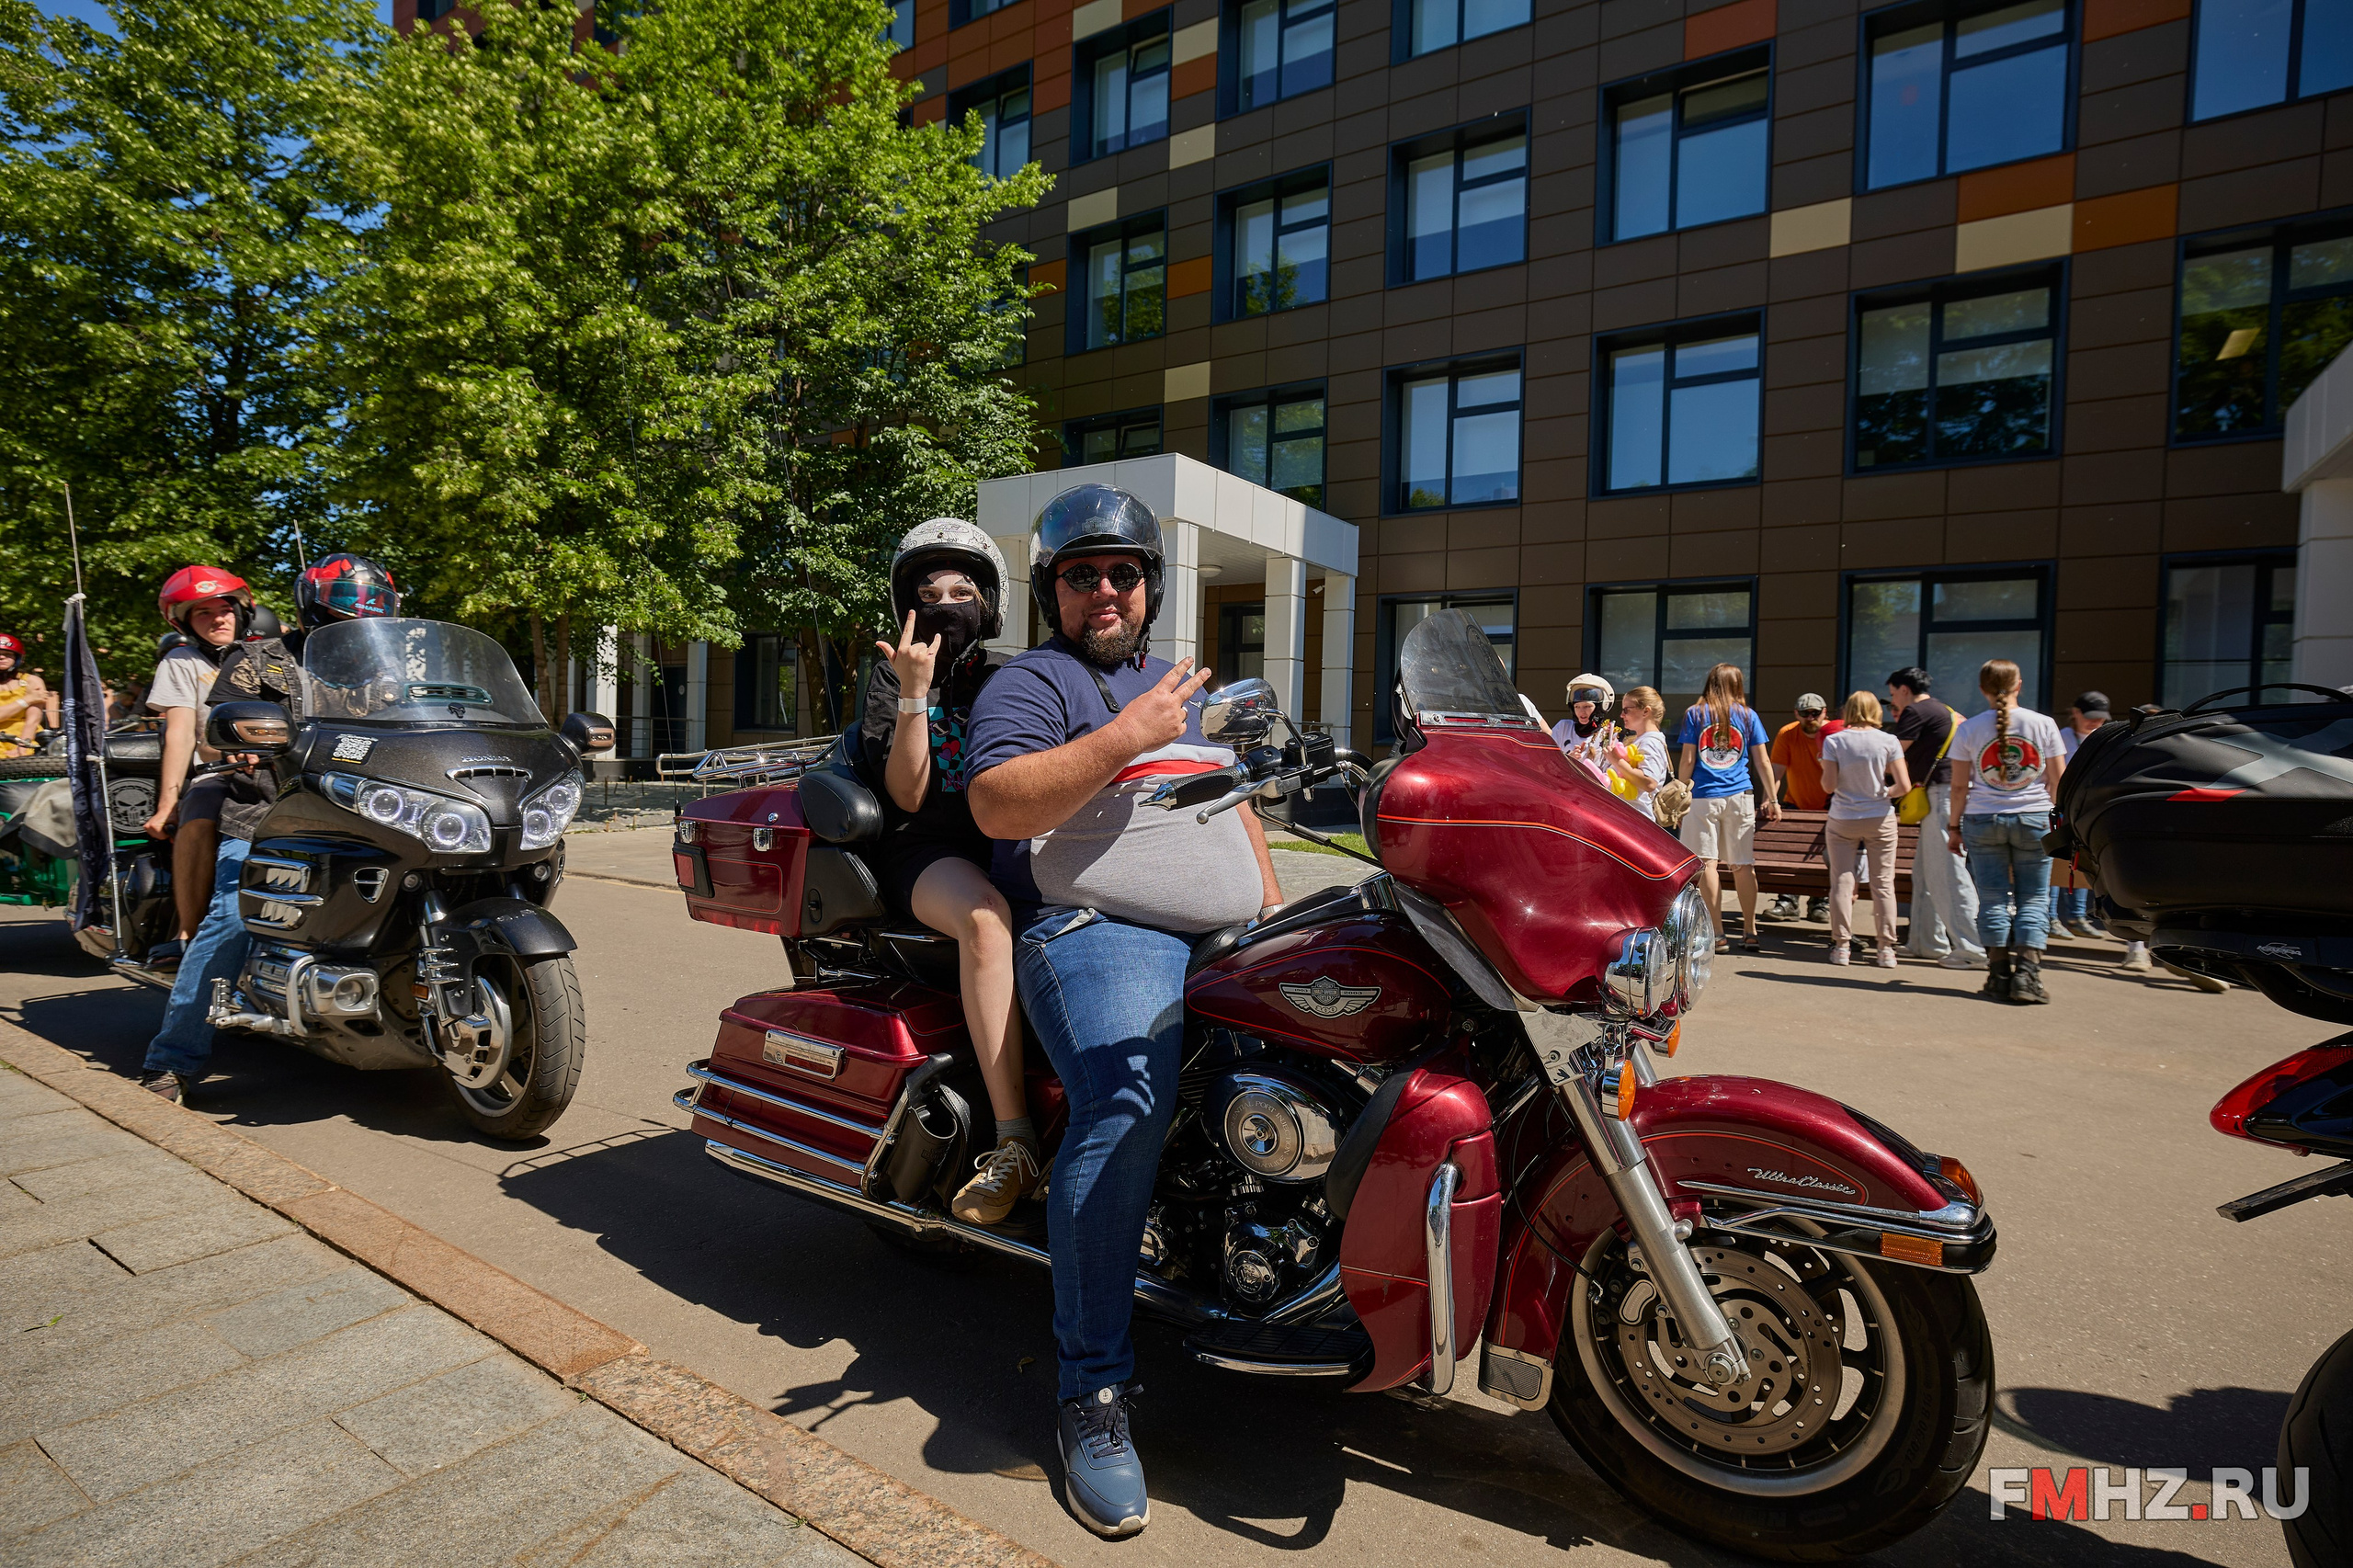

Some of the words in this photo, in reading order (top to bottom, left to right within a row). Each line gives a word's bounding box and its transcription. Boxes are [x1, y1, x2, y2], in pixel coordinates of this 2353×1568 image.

[355, 602, 384, 614] SHARK
[460, 755, 513, 763] HONDA
[1255, 1100, 1277, 1113] PORT
[1275, 1112, 1291, 1155] INJECTION
